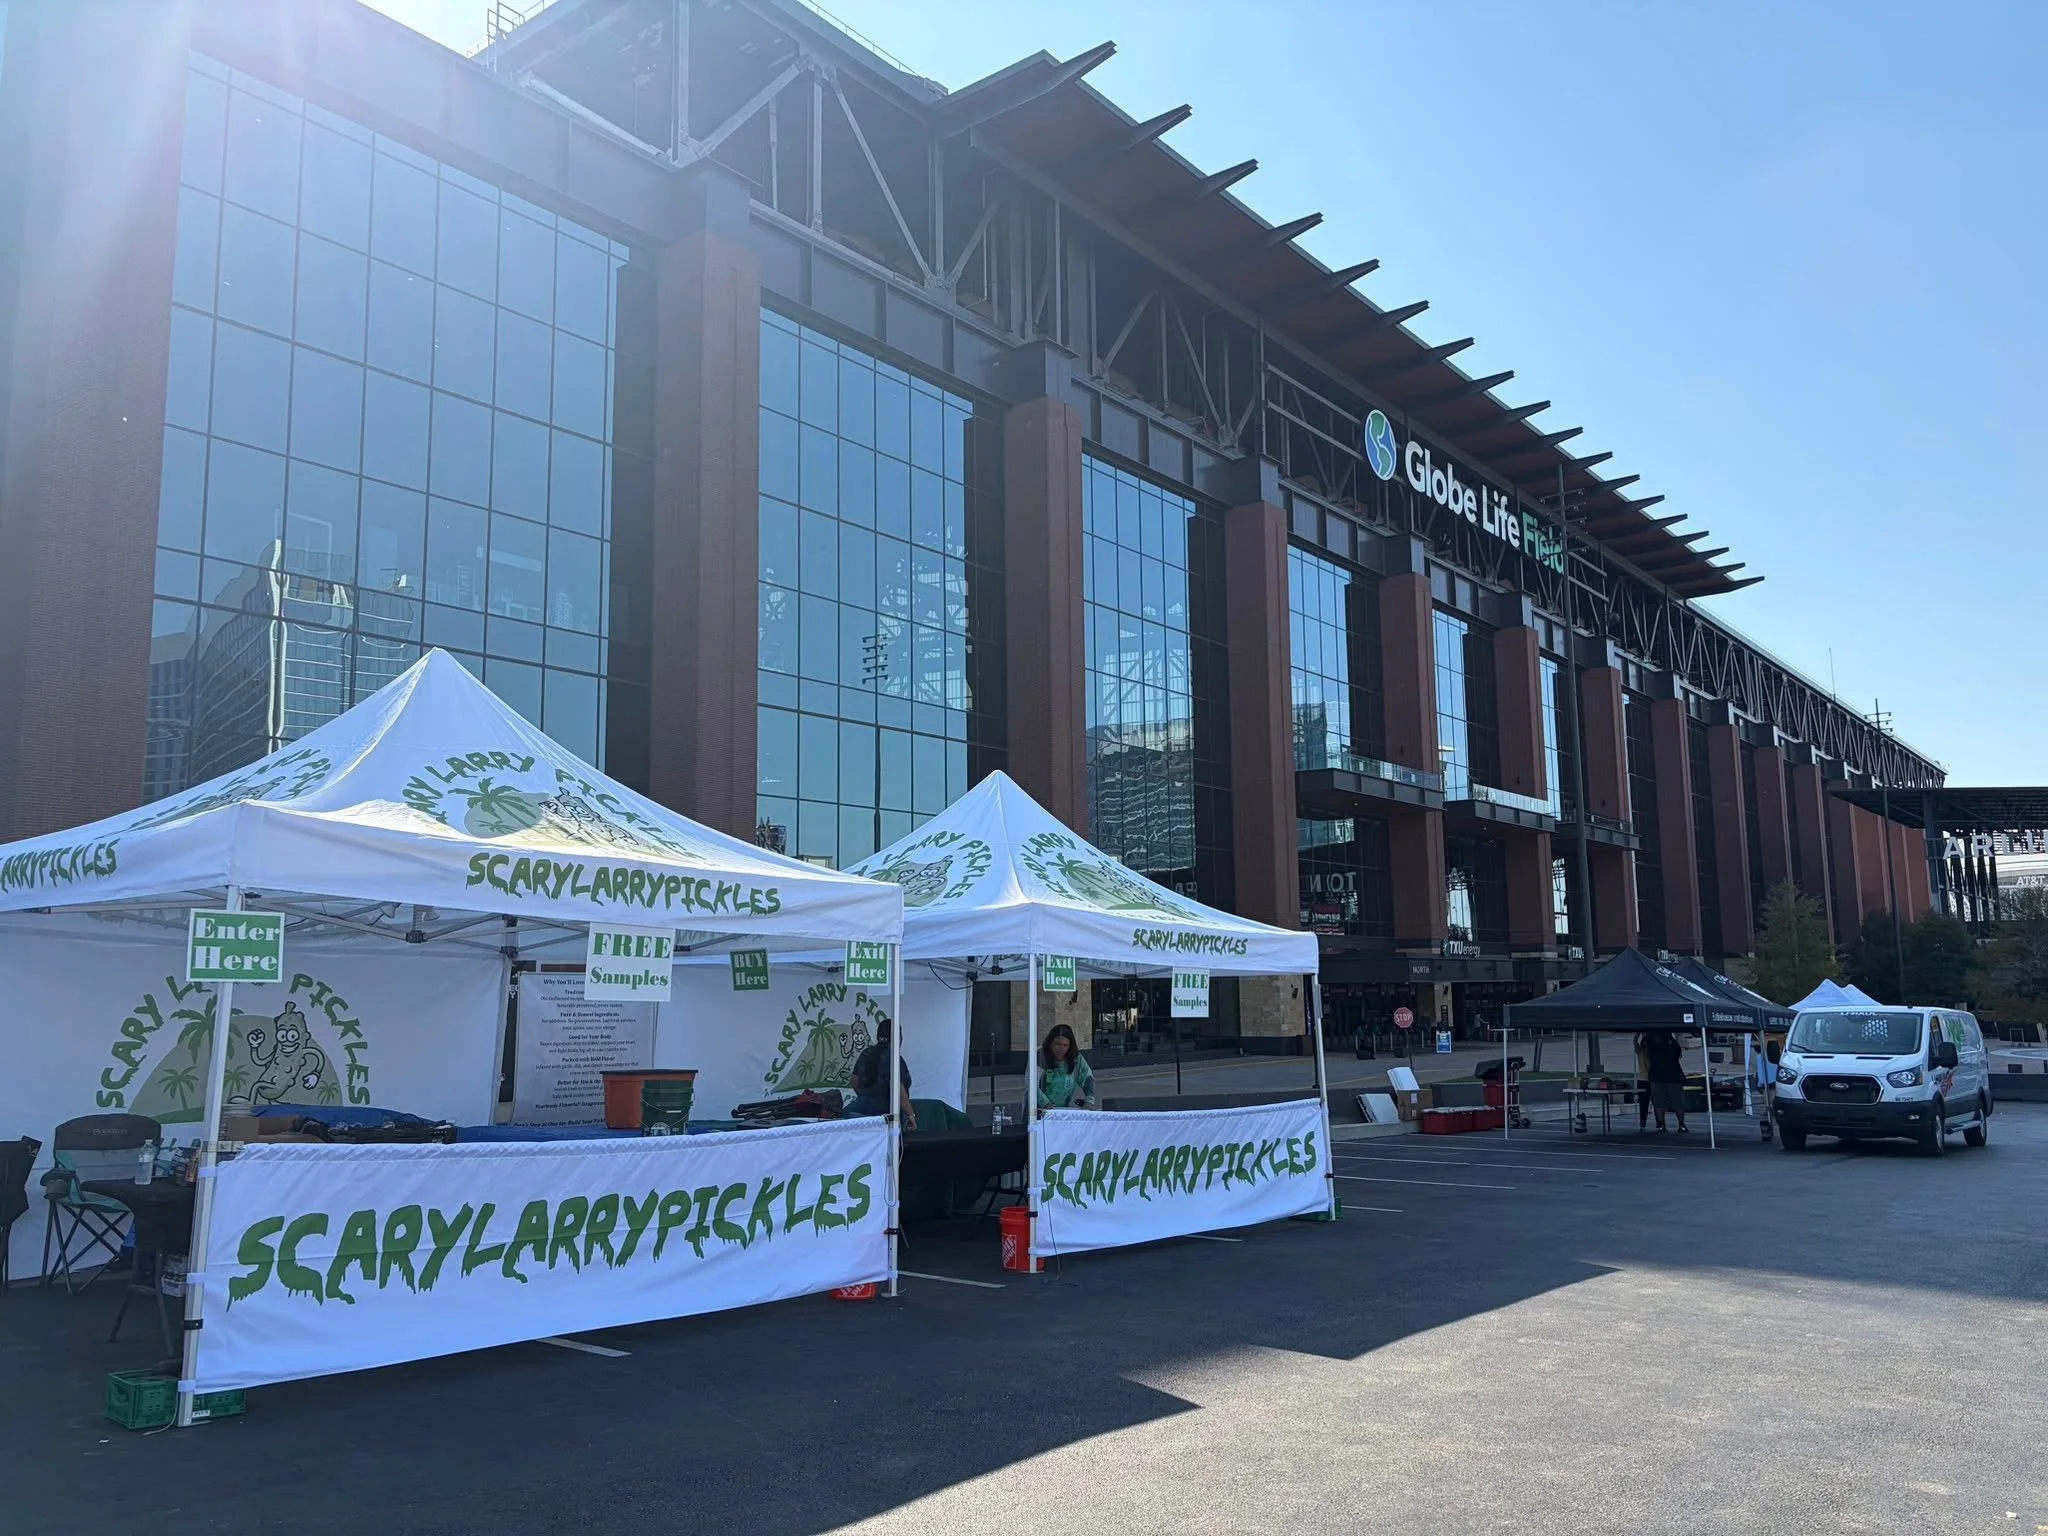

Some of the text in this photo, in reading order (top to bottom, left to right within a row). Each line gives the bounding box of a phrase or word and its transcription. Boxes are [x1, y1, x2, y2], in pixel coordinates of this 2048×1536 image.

[1405, 440, 1565, 575] Globe Life Field
[425, 751, 535, 784] LARRY
[1021, 832, 1076, 857] LARRY
[943, 840, 992, 899] PICKLES
[2016, 876, 2045, 886] AT&T
[466, 852, 781, 916] SCARYLARRYPICKLES
[194, 917, 280, 942] Enter
[1132, 928, 1248, 955] SCARYLARRYPICKLES
[193, 945, 278, 971] Here
[592, 932, 674, 960] FREE
[851, 942, 885, 960] Exit
[733, 952, 764, 968] BUY
[850, 963, 885, 979] Here
[1046, 955, 1073, 969] Exit
[1412, 966, 1430, 974] NORTH
[590, 966, 669, 992] Samples
[735, 971, 767, 986] Here
[1046, 971, 1073, 985] Here
[1174, 973, 1208, 989] FREE
[1173, 995, 1208, 1010] Samples
[1394, 1012, 1411, 1022] STOP
[96, 973, 370, 1108] SCARY PICKLES
[764, 982, 847, 1084] SCARY LARRY
[1041, 1131, 1317, 1209] SCARYLARRYPICKLES
[226, 1162, 872, 1312] SCARYLARRYPICKLES
